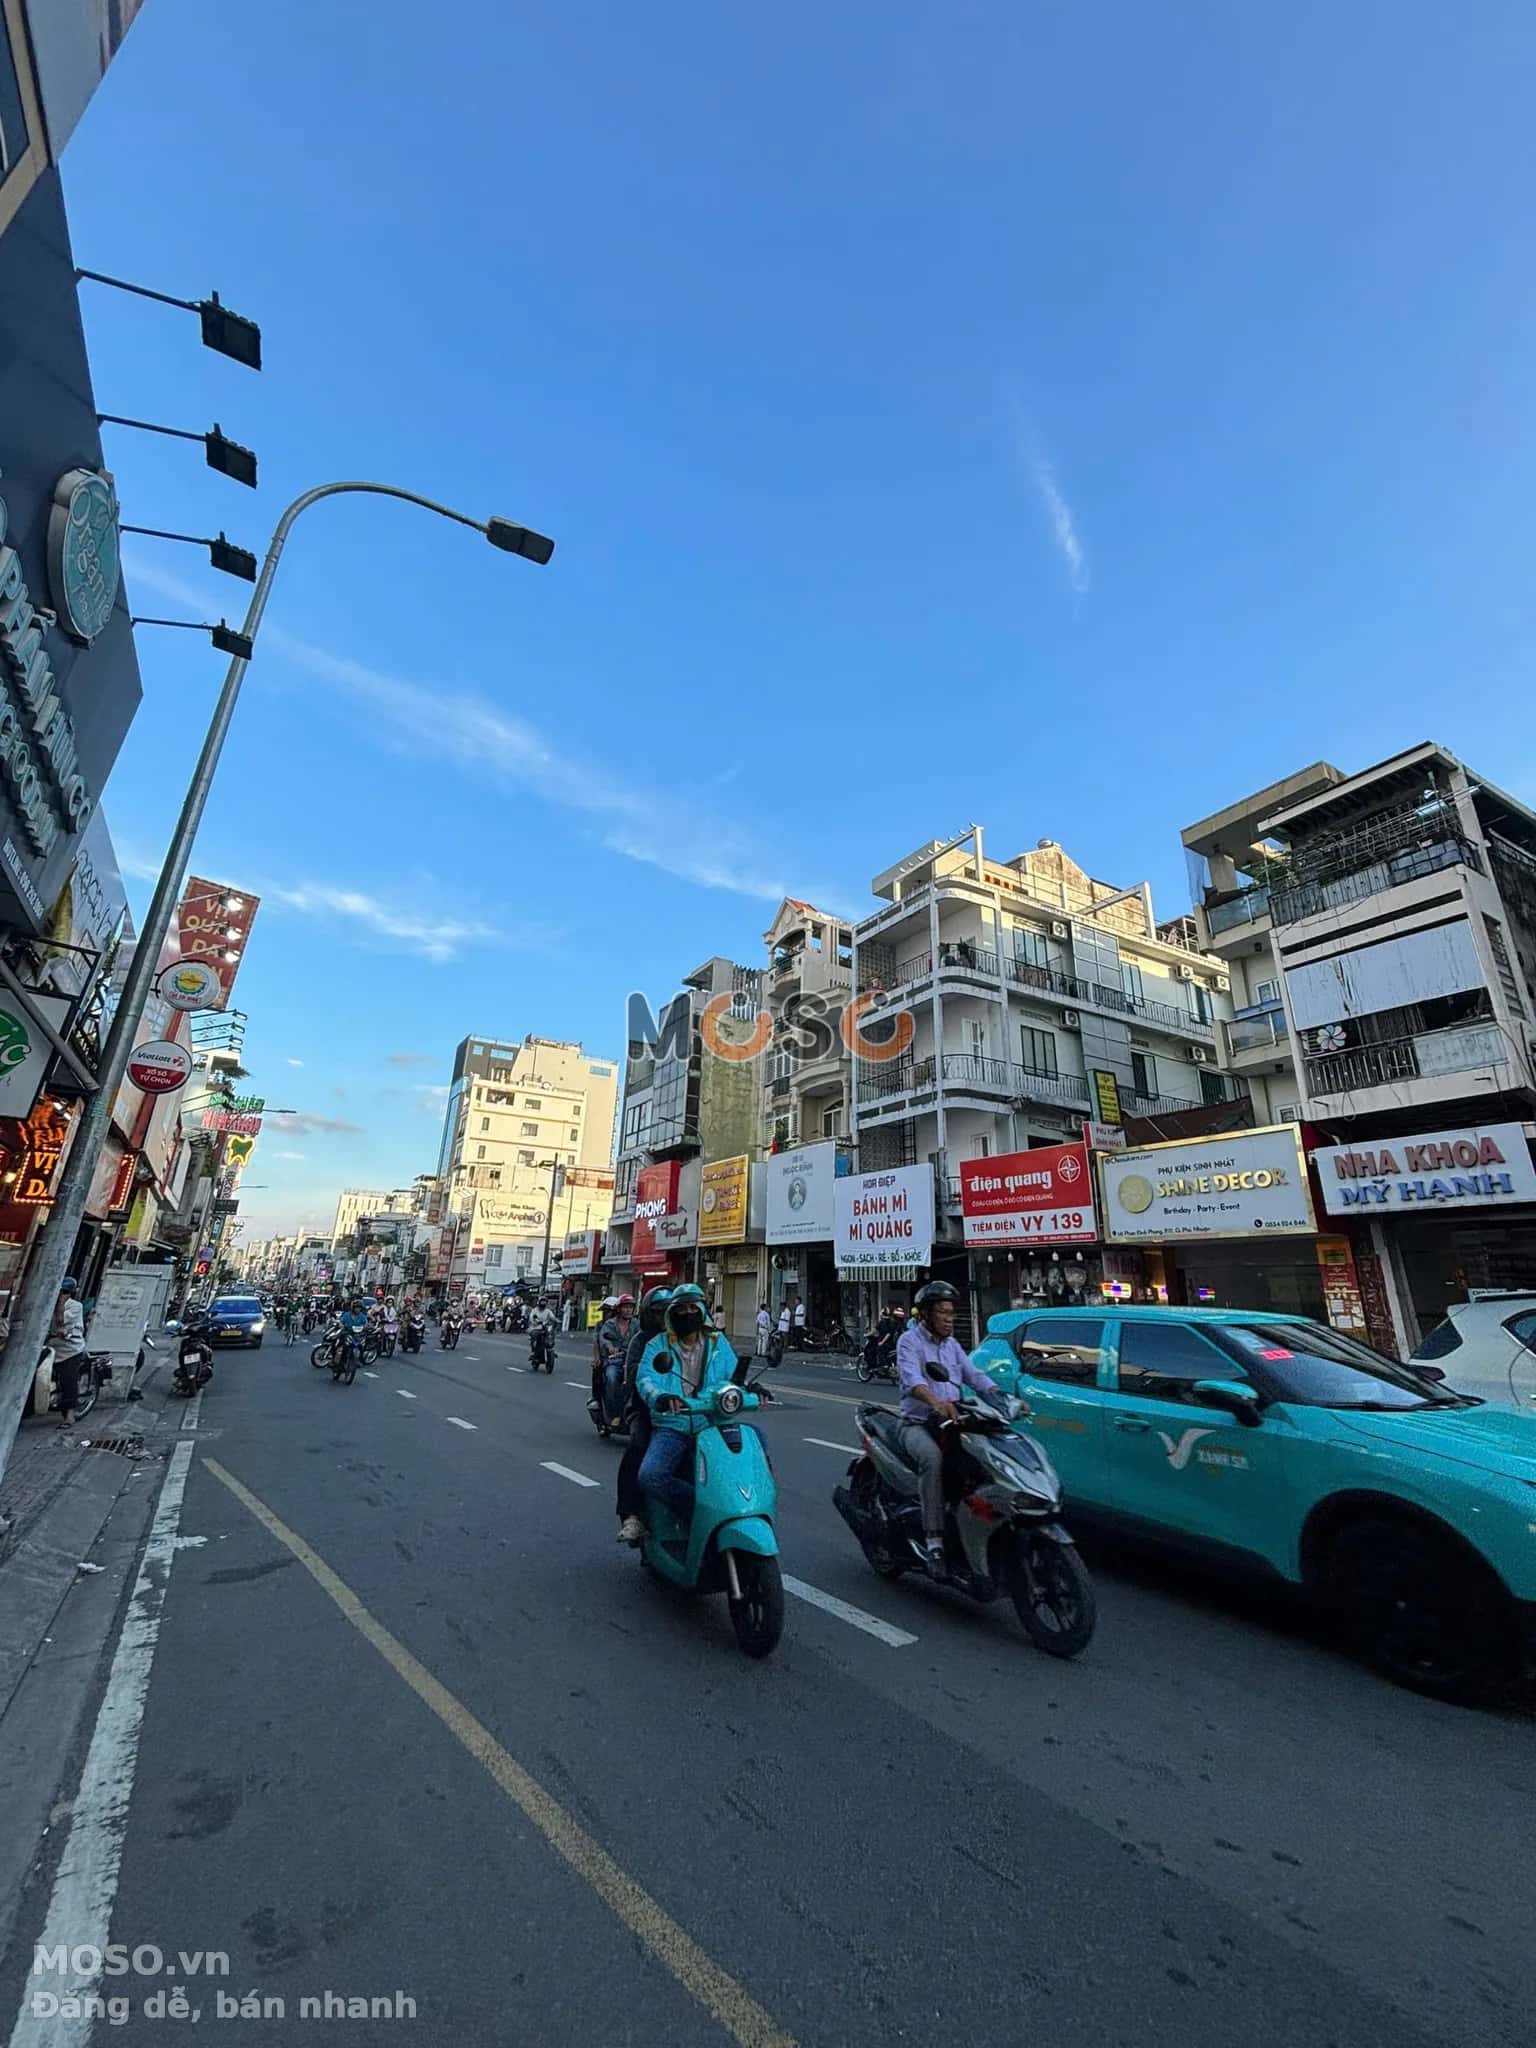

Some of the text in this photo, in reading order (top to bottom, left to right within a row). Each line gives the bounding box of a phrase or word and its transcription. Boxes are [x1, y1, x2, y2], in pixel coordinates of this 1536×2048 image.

[137, 1051, 171, 1065] Vietlott
[1157, 1165, 1173, 1175] PHỤ
[1174, 1164, 1191, 1174] KIỆN
[1333, 1136, 1506, 1180] NHA KHOA
[1004, 1170, 1053, 1193] quang
[1155, 1168, 1288, 1199] SHINE DECOR
[1338, 1172, 1515, 1206] MỸ HẠNH
[635, 1199, 666, 1219] PHONG
[853, 1190, 908, 1216] BÁNH MÌ
[1163, 1202, 1240, 1216] Birthday Party Event
[849, 1215, 912, 1243] MÌ QUẢNG
[1020, 1214, 1044, 1232] VY
[1050, 1211, 1083, 1230] 139
